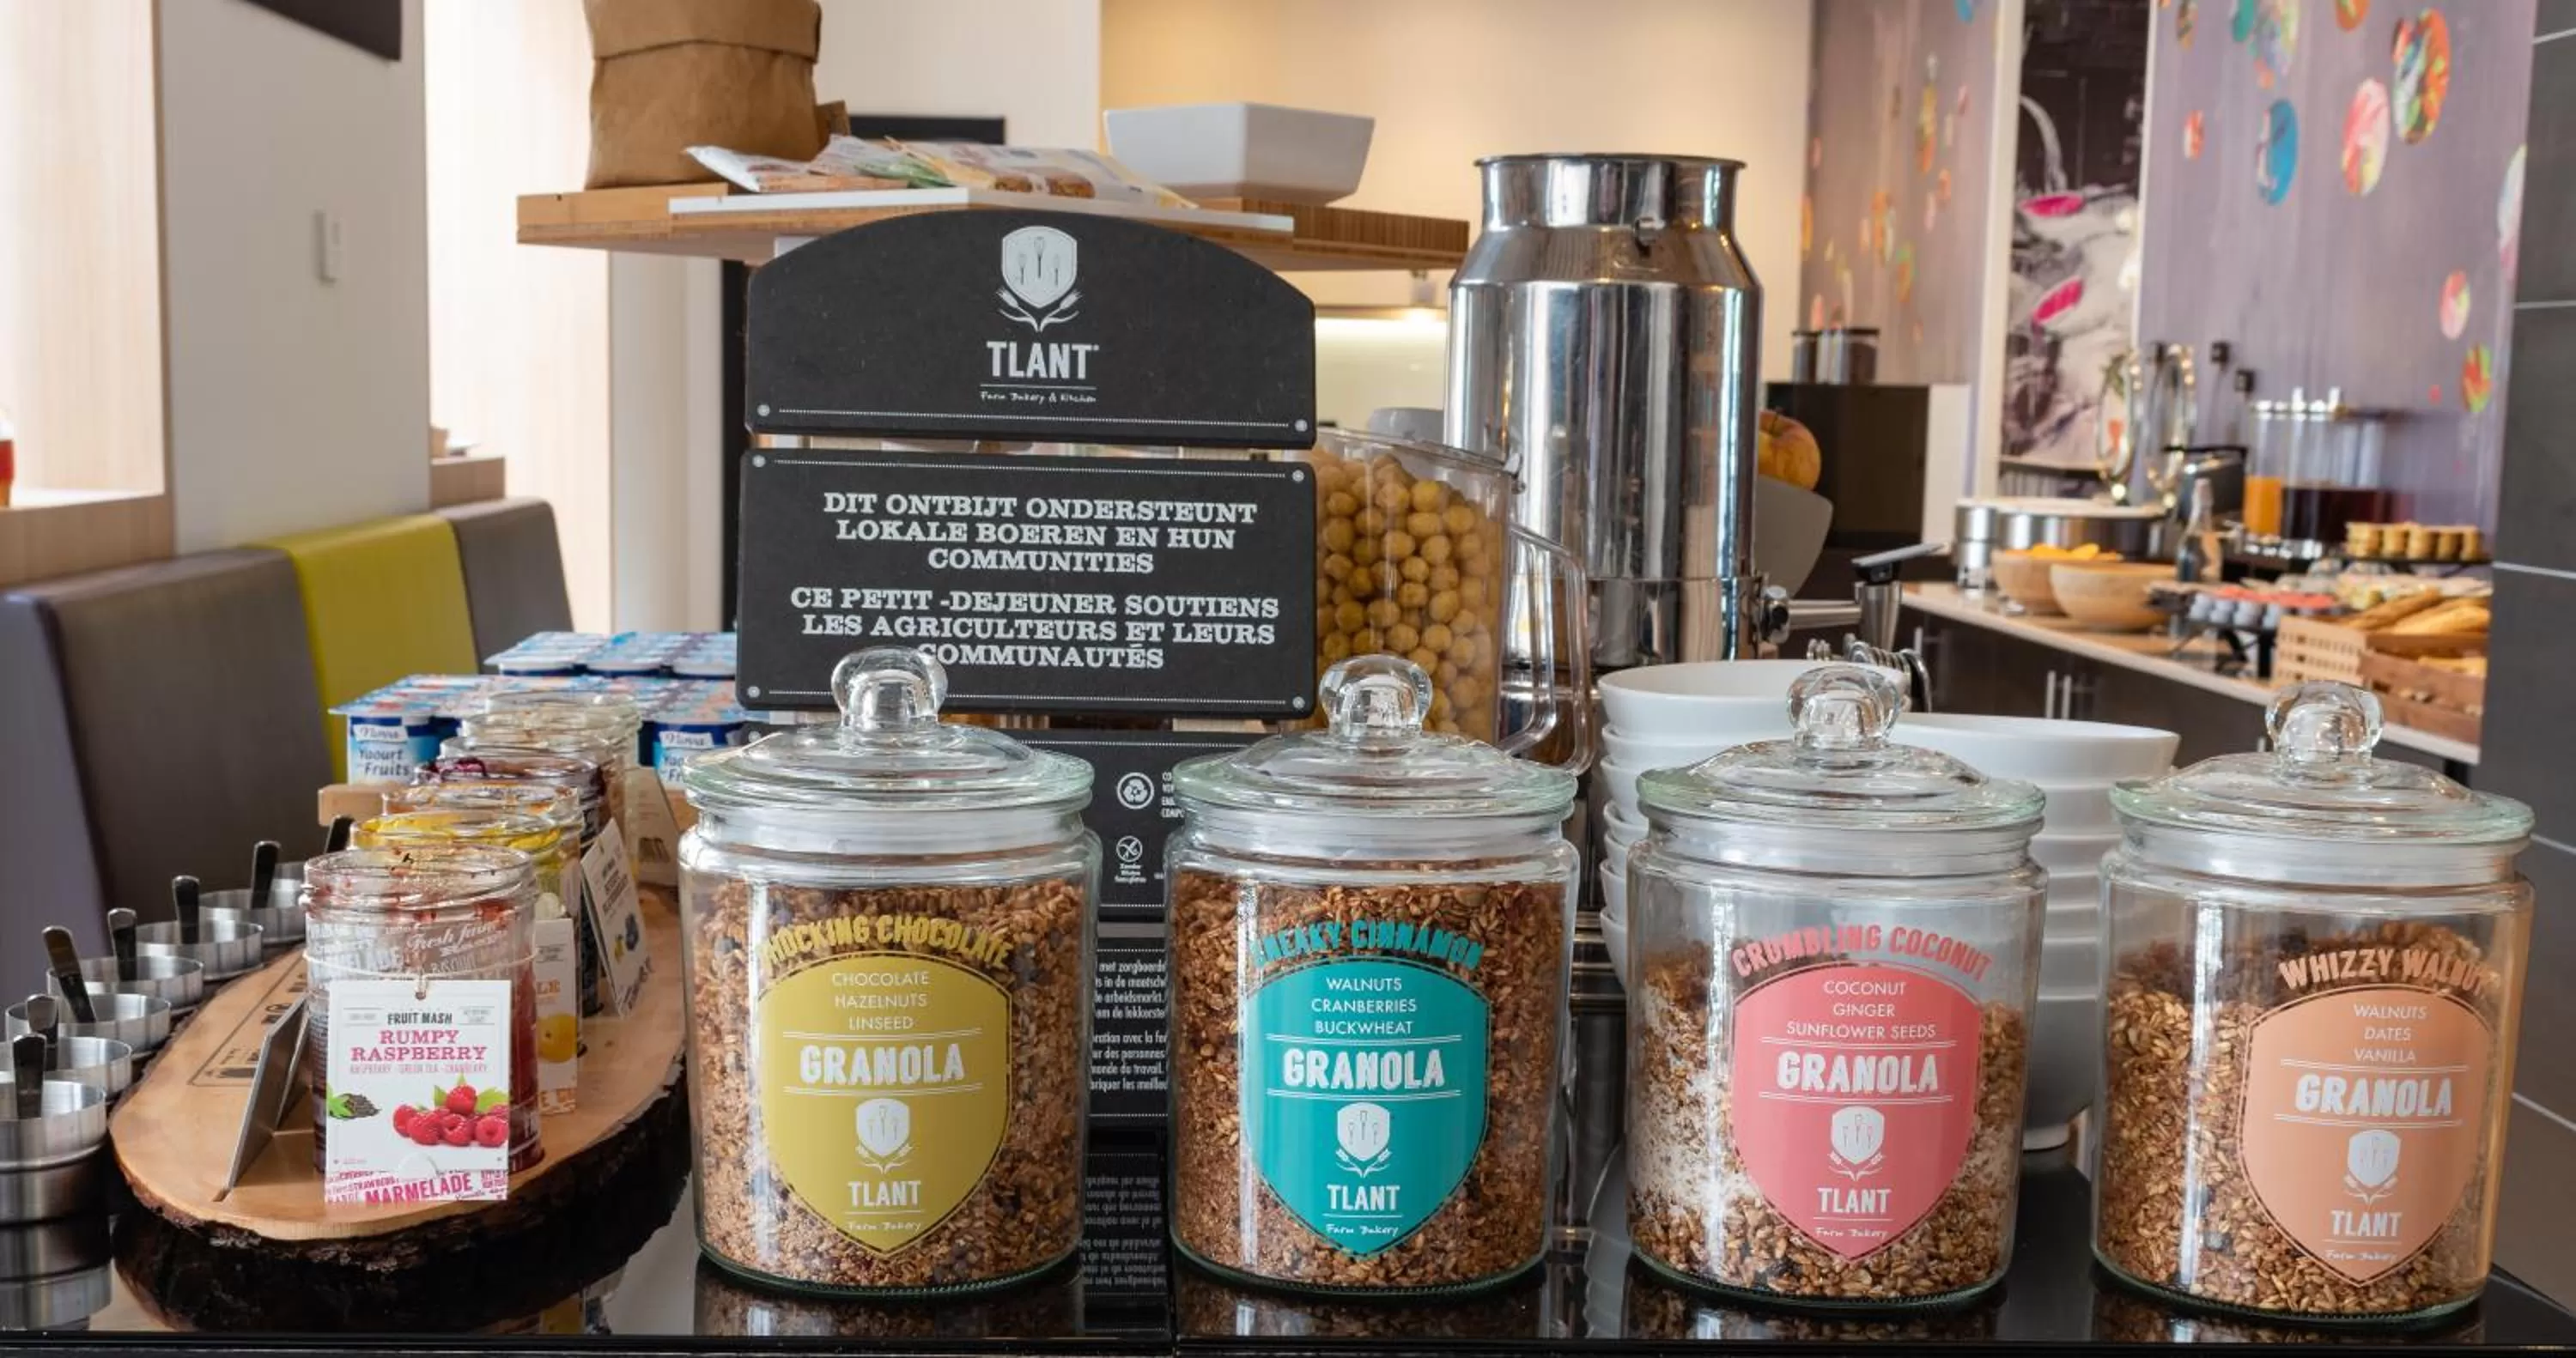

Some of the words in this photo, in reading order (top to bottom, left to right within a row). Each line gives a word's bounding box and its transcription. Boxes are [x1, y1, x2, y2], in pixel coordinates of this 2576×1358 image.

[986, 341, 1092, 379] TLANT
[823, 492, 878, 514] DIT
[885, 494, 1018, 518] ONTBIJT
[1026, 497, 1258, 524] ONDERSTEUNT
[835, 518, 968, 543] LOKALE
[975, 522, 1108, 547] BOEREN
[1115, 525, 1159, 548] EN
[1167, 527, 1236, 550] HUN
[927, 548, 1155, 574] COMMUNITIES
[790, 586, 833, 609] CE
[840, 588, 933, 610] PETIT
[1124, 595, 1280, 619] SOUTIENS
[801, 613, 863, 636] LES
[869, 615, 1117, 642] AGRICULTEURS
[1124, 620, 1165, 643] ET
[1171, 621, 1275, 645] LEURS
[875, 913, 1015, 970] CHOCOLATE
[1731, 924, 1883, 979] CRUMBLING
[1889, 925, 1995, 982] COCONUT
[831, 971, 930, 987] CHOCOLATE
[2277, 947, 2397, 990] WHIZZY
[1325, 977, 1403, 992] WALNUTS
[1823, 980, 1907, 996] COCONUT
[835, 993, 928, 1009] HAZELNUTS
[1310, 998, 1418, 1014] CRANBERRIES
[1832, 1003, 1896, 1018] GINGER
[2353, 1003, 2428, 1020] WALNUTS
[387, 1012, 419, 1026] FRUIT
[421, 1012, 453, 1025] MASH
[848, 1015, 914, 1031] LINSEED
[1315, 1020, 1414, 1035] BUCKWHEAT
[1786, 1021, 1886, 1040] SUNFLOWER
[1891, 1024, 1938, 1040] SEEDS
[379, 1029, 460, 1046] RUMPY
[2363, 1026, 2412, 1042] DATES
[350, 1046, 488, 1062] RASPBERRY
[799, 1043, 966, 1086] GRANOLA
[2353, 1048, 2416, 1064] VANILLA
[1283, 1048, 1446, 1091] GRANOLA
[1776, 1051, 1940, 1094] GRANOLA
[2295, 1073, 2453, 1117] GRANOLA
[363, 1172, 473, 1206] MARMELADE
[848, 1180, 921, 1207] TLANT
[1326, 1184, 1400, 1211] TLANT
[1816, 1187, 1893, 1215] TLANT
[2330, 1209, 2403, 1238] TLANT
